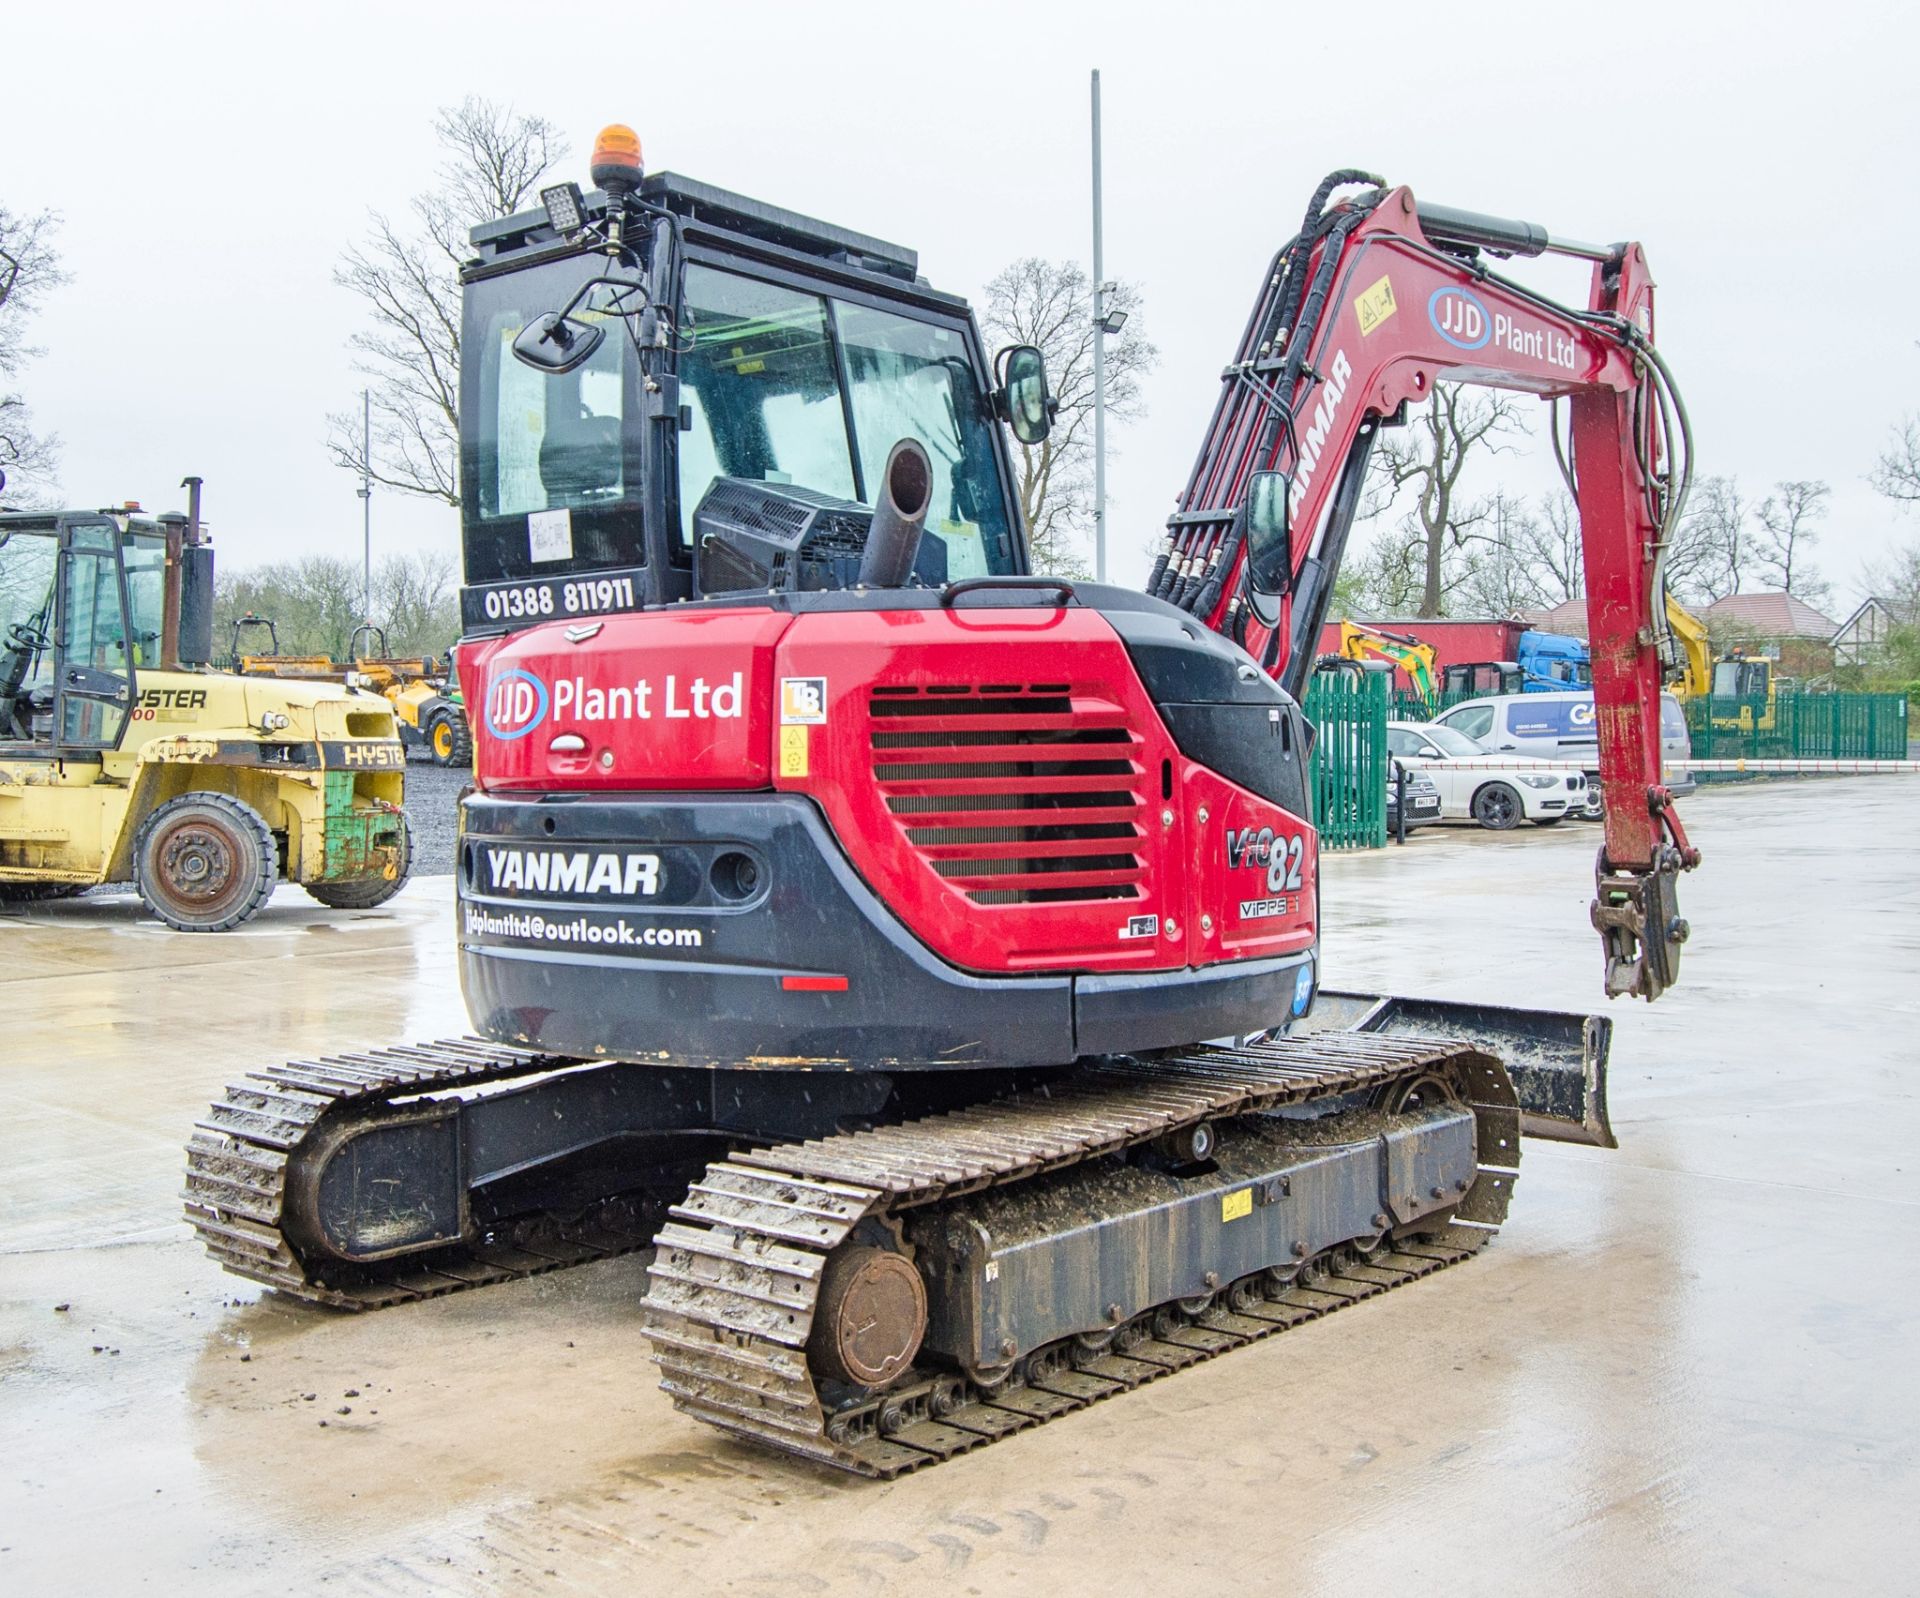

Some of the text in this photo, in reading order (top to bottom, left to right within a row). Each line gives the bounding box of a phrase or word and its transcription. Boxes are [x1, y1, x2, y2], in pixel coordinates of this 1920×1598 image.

[1442, 297, 1575, 369] JJD Plant Ltd
[1288, 349, 1352, 530] ANMAR
[485, 578, 634, 619] 01388 811911
[493, 672, 743, 725] JJD Plant Ltd
[487, 849, 660, 895] YANMAR
[465, 908, 702, 947] jjdplantltd@outlook.com
